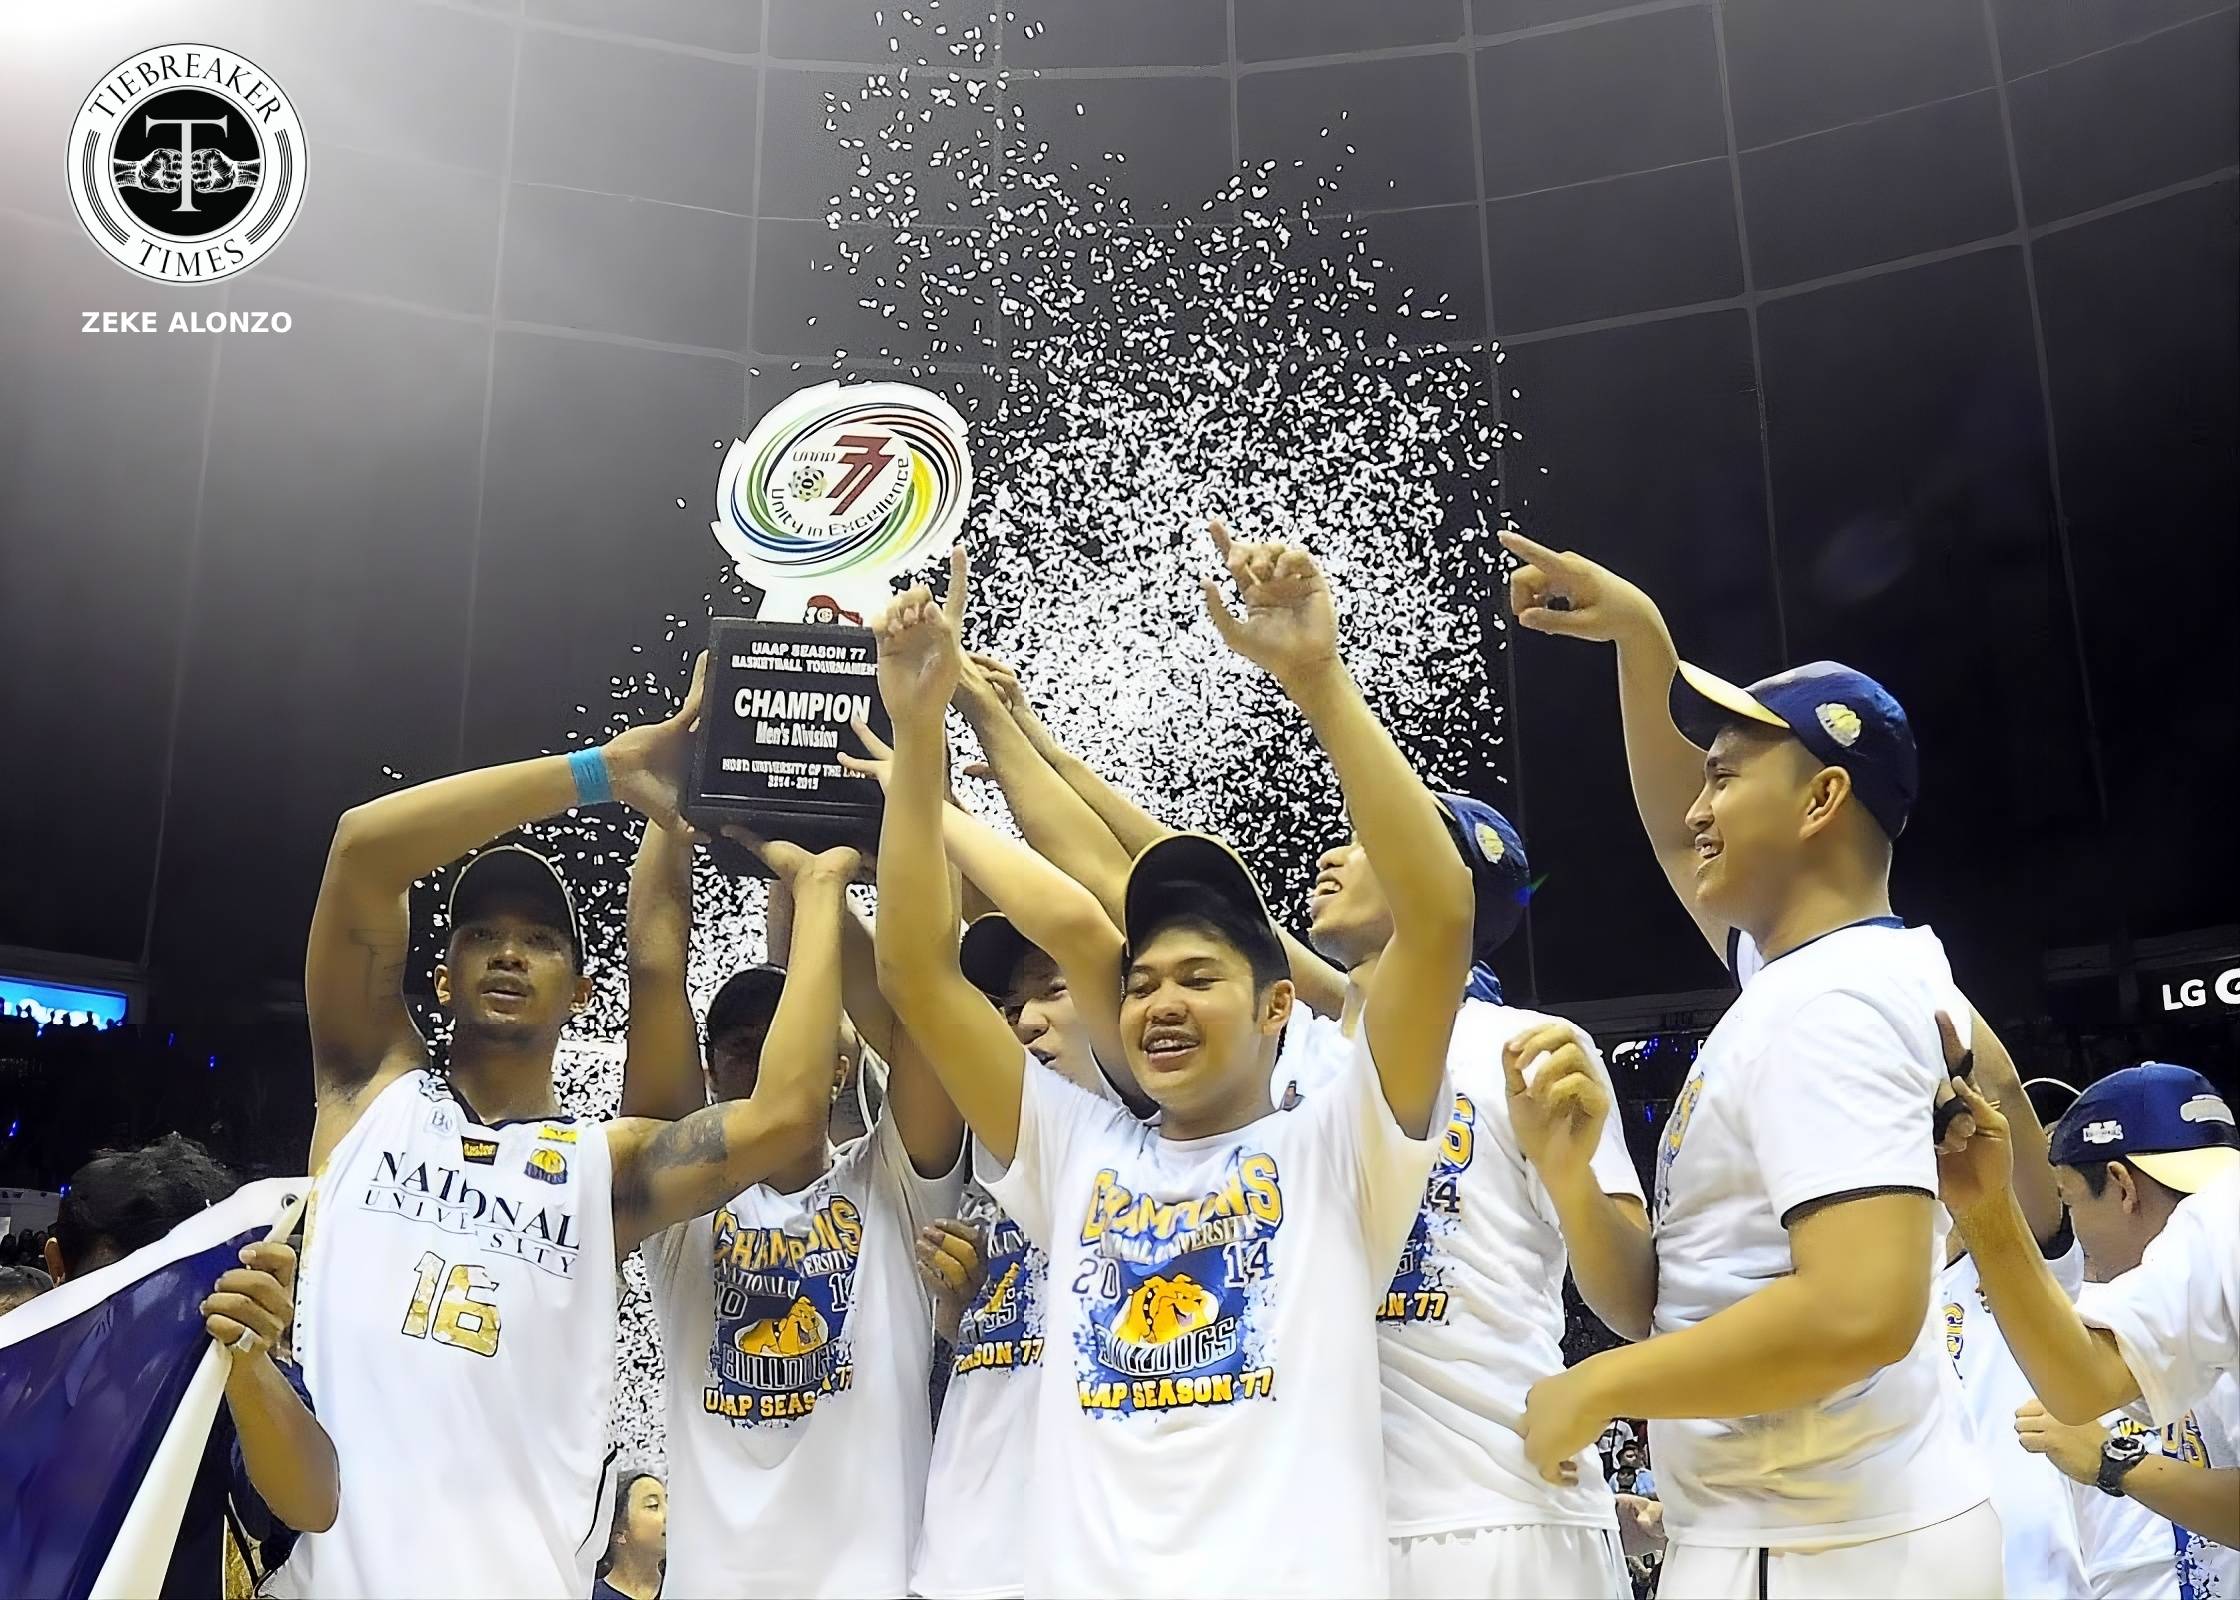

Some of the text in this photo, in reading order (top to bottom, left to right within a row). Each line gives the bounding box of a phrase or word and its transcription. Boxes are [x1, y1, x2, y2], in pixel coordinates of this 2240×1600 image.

[828, 456, 909, 536] Excellence
[731, 655, 803, 672] BASKETBALL
[751, 641, 867, 660] UAAP SEASON 77
[734, 687, 871, 725] CHAMPION
[755, 720, 839, 749] Men's Division
[2162, 979, 2207, 1011] LG
[364, 1189, 576, 1274] UNIVESITY
[713, 1193, 863, 1272] CHAMPNS
[1071, 1238, 1275, 1300] 20 14
[401, 1250, 502, 1358] 16
[1413, 1291, 1448, 1320] 77
[1019, 1337, 1045, 1366] 77
[1132, 1374, 1234, 1409] SEASON
[1239, 1366, 1274, 1399] 77
